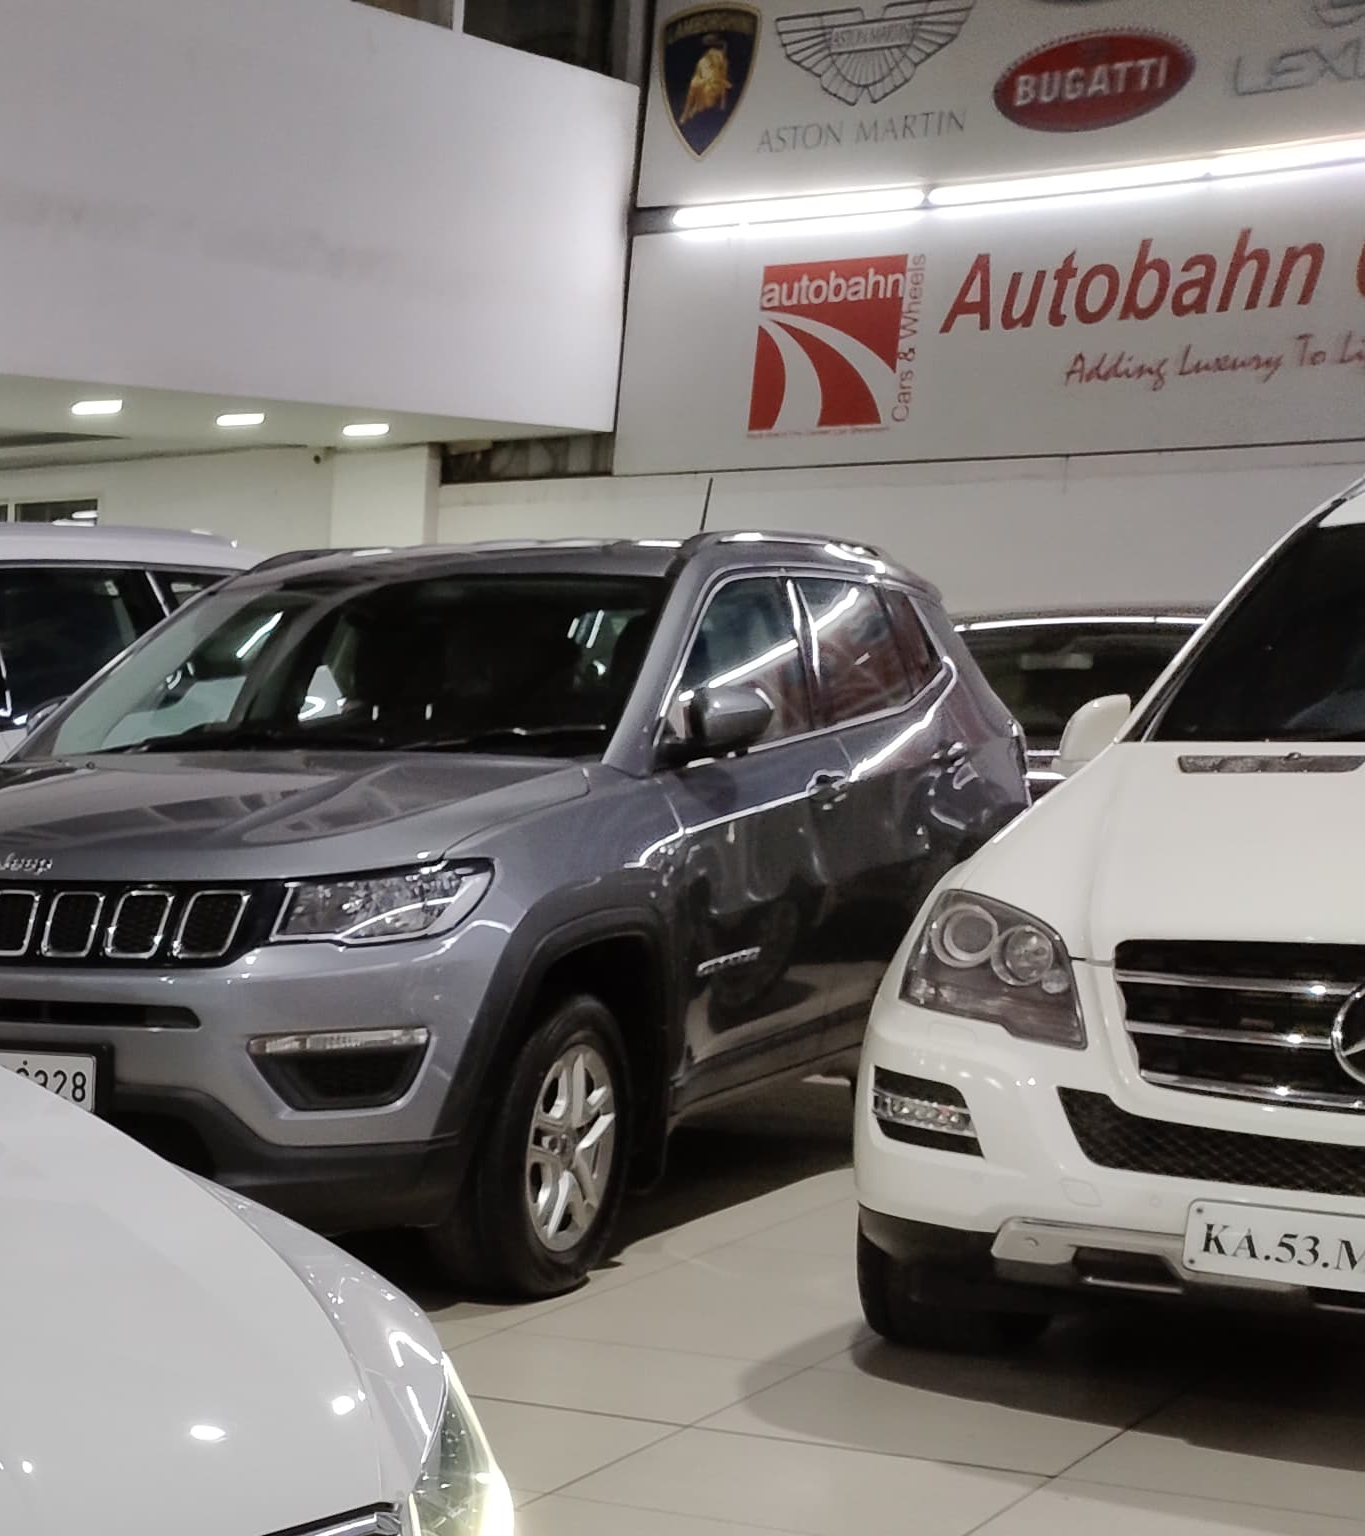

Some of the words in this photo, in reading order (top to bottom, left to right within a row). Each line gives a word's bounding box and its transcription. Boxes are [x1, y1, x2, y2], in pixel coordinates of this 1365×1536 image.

[1013, 56, 1169, 107] BUGATTI
[1233, 38, 1365, 97] LEX
[755, 121, 844, 154] ASTON
[854, 108, 967, 145] MARTIN
[760, 267, 906, 309] autobahn
[900, 253, 926, 341] Wheels
[938, 227, 1326, 335] Autobahn
[898, 347, 916, 363] &
[1064, 351, 1169, 392] Adding
[1177, 343, 1284, 384] Luxury
[1294, 332, 1327, 367] To
[891, 369, 915, 423] Cars
